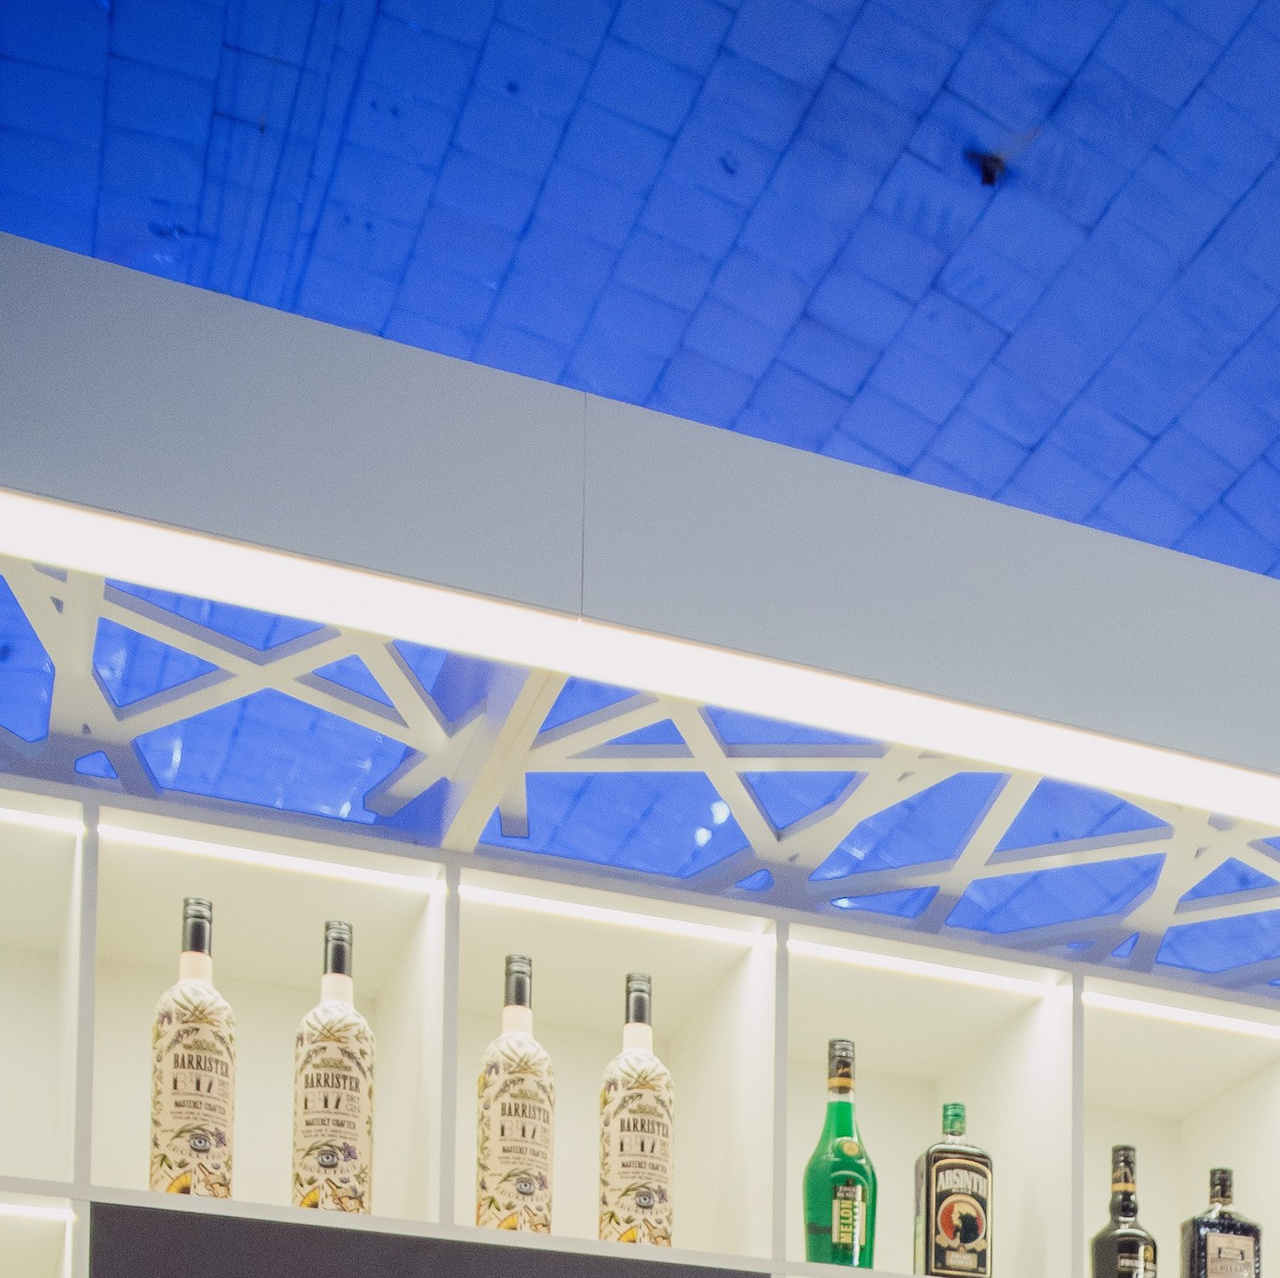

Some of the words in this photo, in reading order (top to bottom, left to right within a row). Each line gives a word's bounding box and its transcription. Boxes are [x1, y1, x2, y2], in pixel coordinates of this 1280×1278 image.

[173, 1053, 229, 1078] BARRISTER
[304, 1073, 361, 1093] BARRISTER
[937, 1169, 988, 1197] ABSINTH
